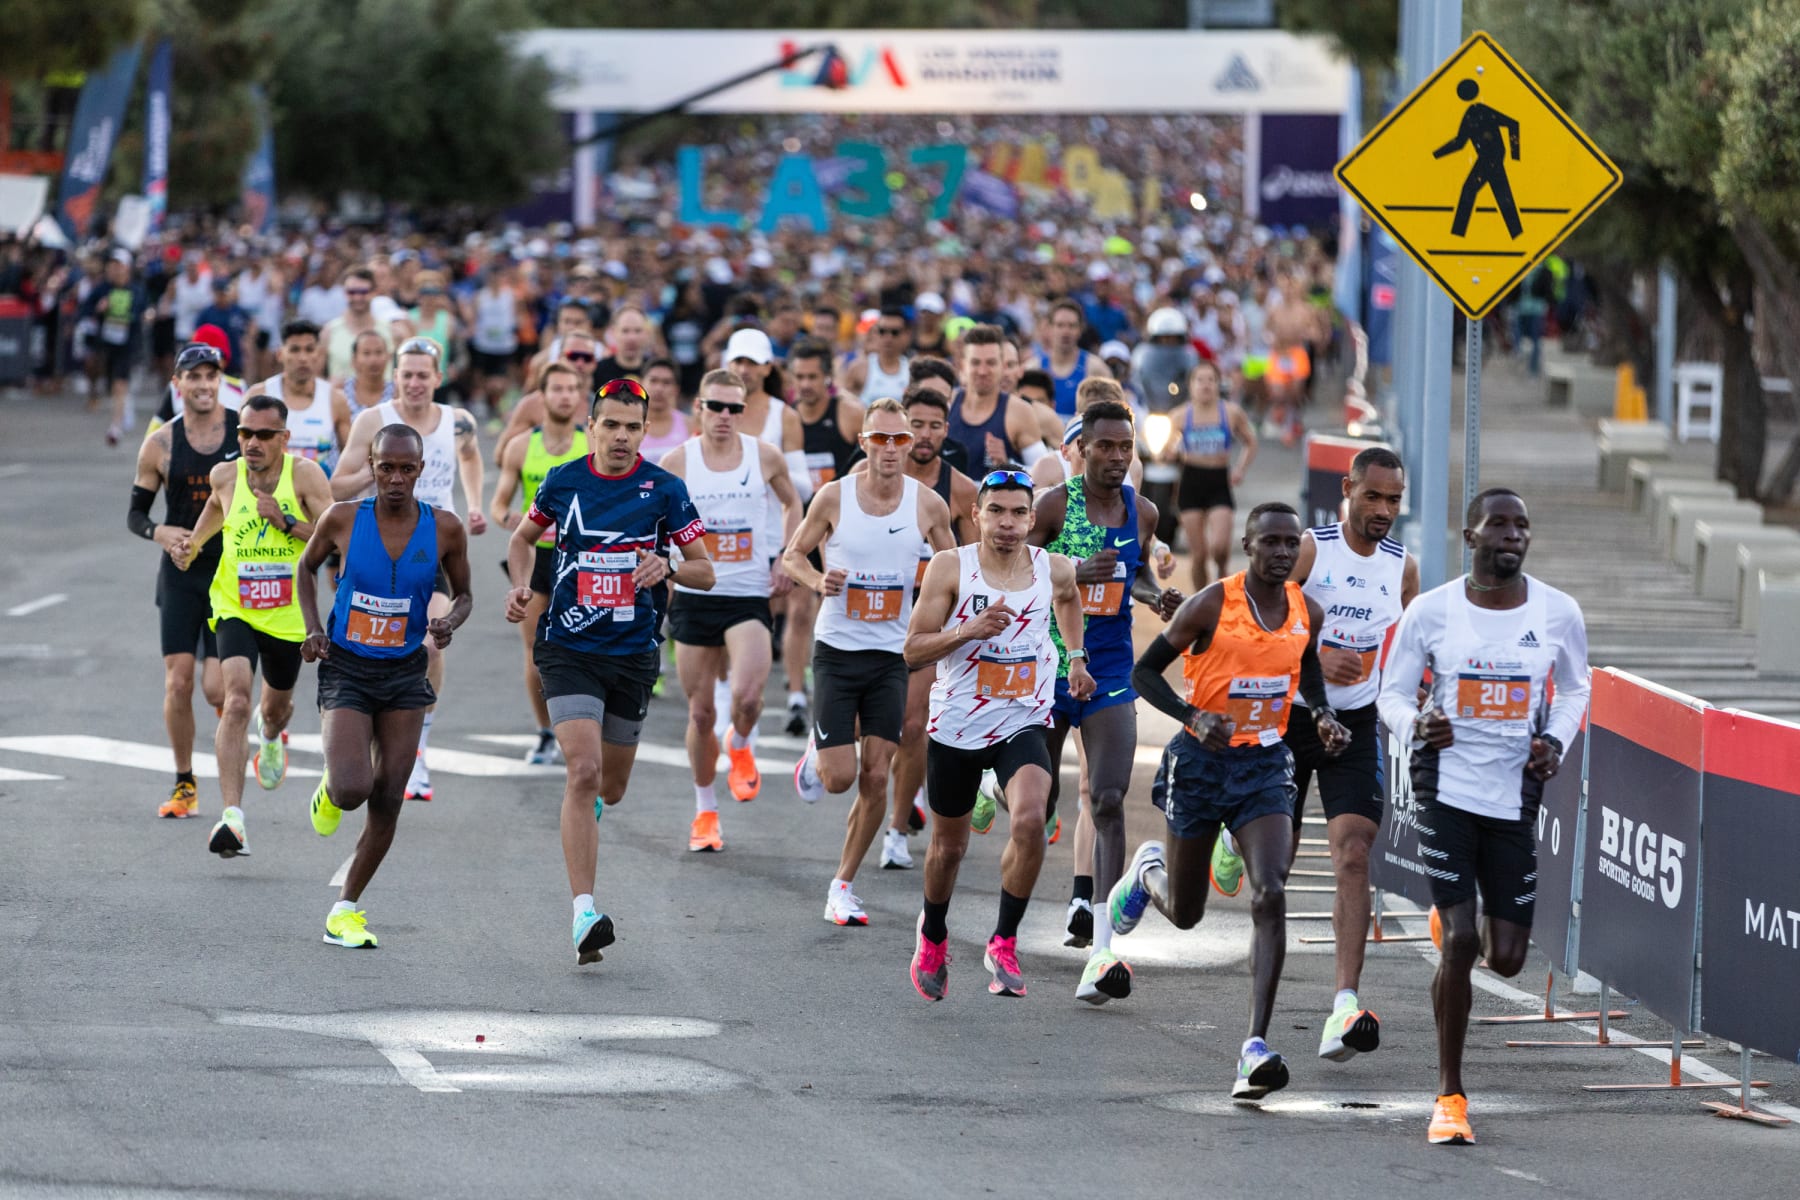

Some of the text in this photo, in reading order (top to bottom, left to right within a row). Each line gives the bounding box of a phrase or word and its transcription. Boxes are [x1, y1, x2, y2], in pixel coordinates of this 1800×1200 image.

[680, 530, 696, 542] US
[718, 534, 737, 552] 23
[237, 546, 295, 558] RUNNERS
[250, 581, 280, 599] 200
[592, 575, 621, 594] 201
[1086, 584, 1105, 603] 18
[866, 592, 884, 610] 16
[560, 606, 584, 628] US
[1328, 604, 1373, 621] Arnet
[369, 617, 388, 636] 17
[1005, 665, 1016, 686] 7
[1480, 683, 1508, 705] 20
[1249, 700, 1263, 721] 2
[1598, 855, 1656, 902] SPORTING GOODS
